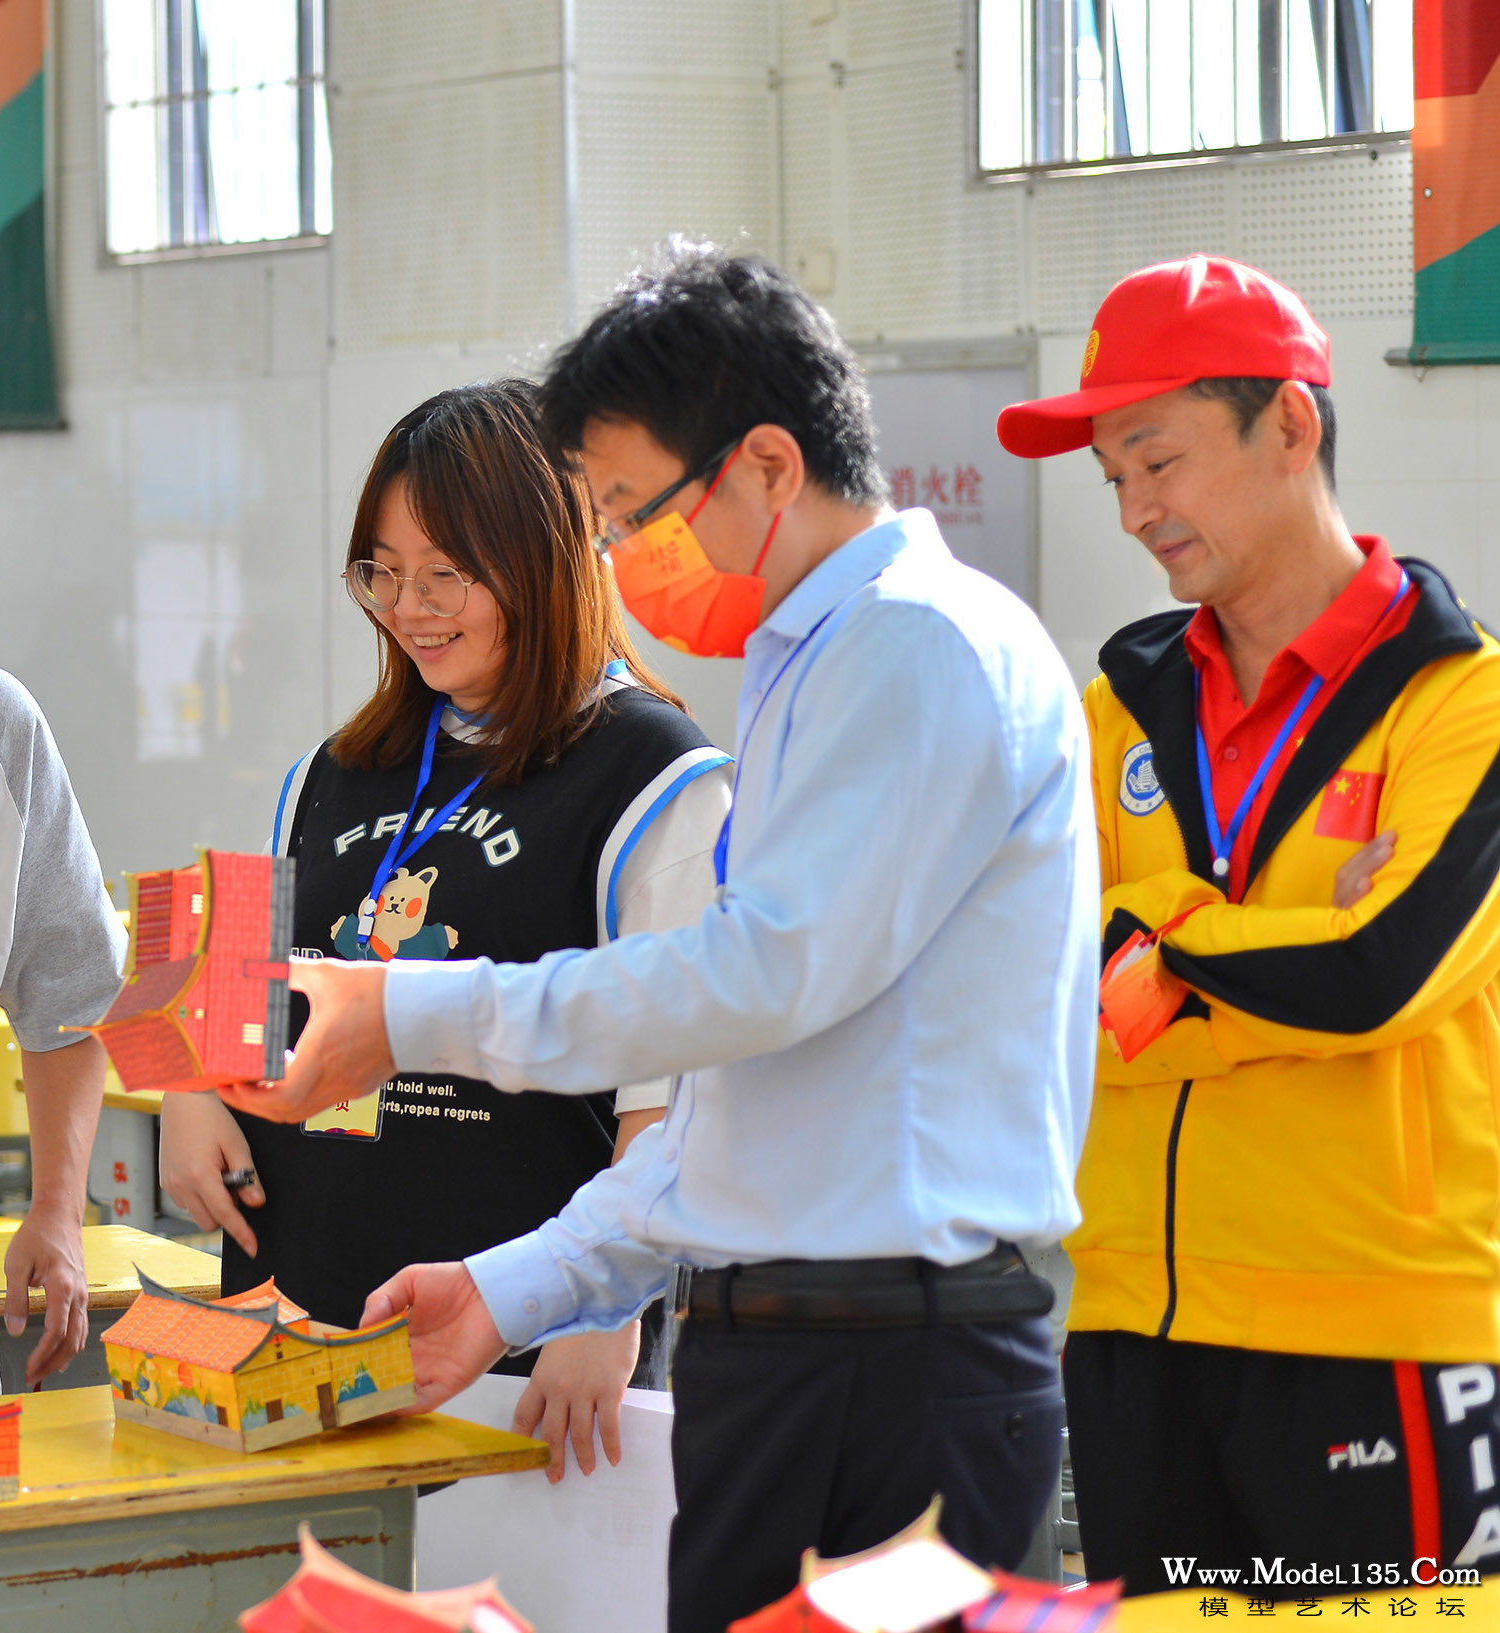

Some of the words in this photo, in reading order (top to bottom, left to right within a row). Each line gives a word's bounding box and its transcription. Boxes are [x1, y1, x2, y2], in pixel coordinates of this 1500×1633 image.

[396, 1080, 423, 1094] hold
[427, 1084, 457, 1097] well.
[444, 1106, 491, 1122] regrets
[1327, 1436, 1397, 1471] FILA
